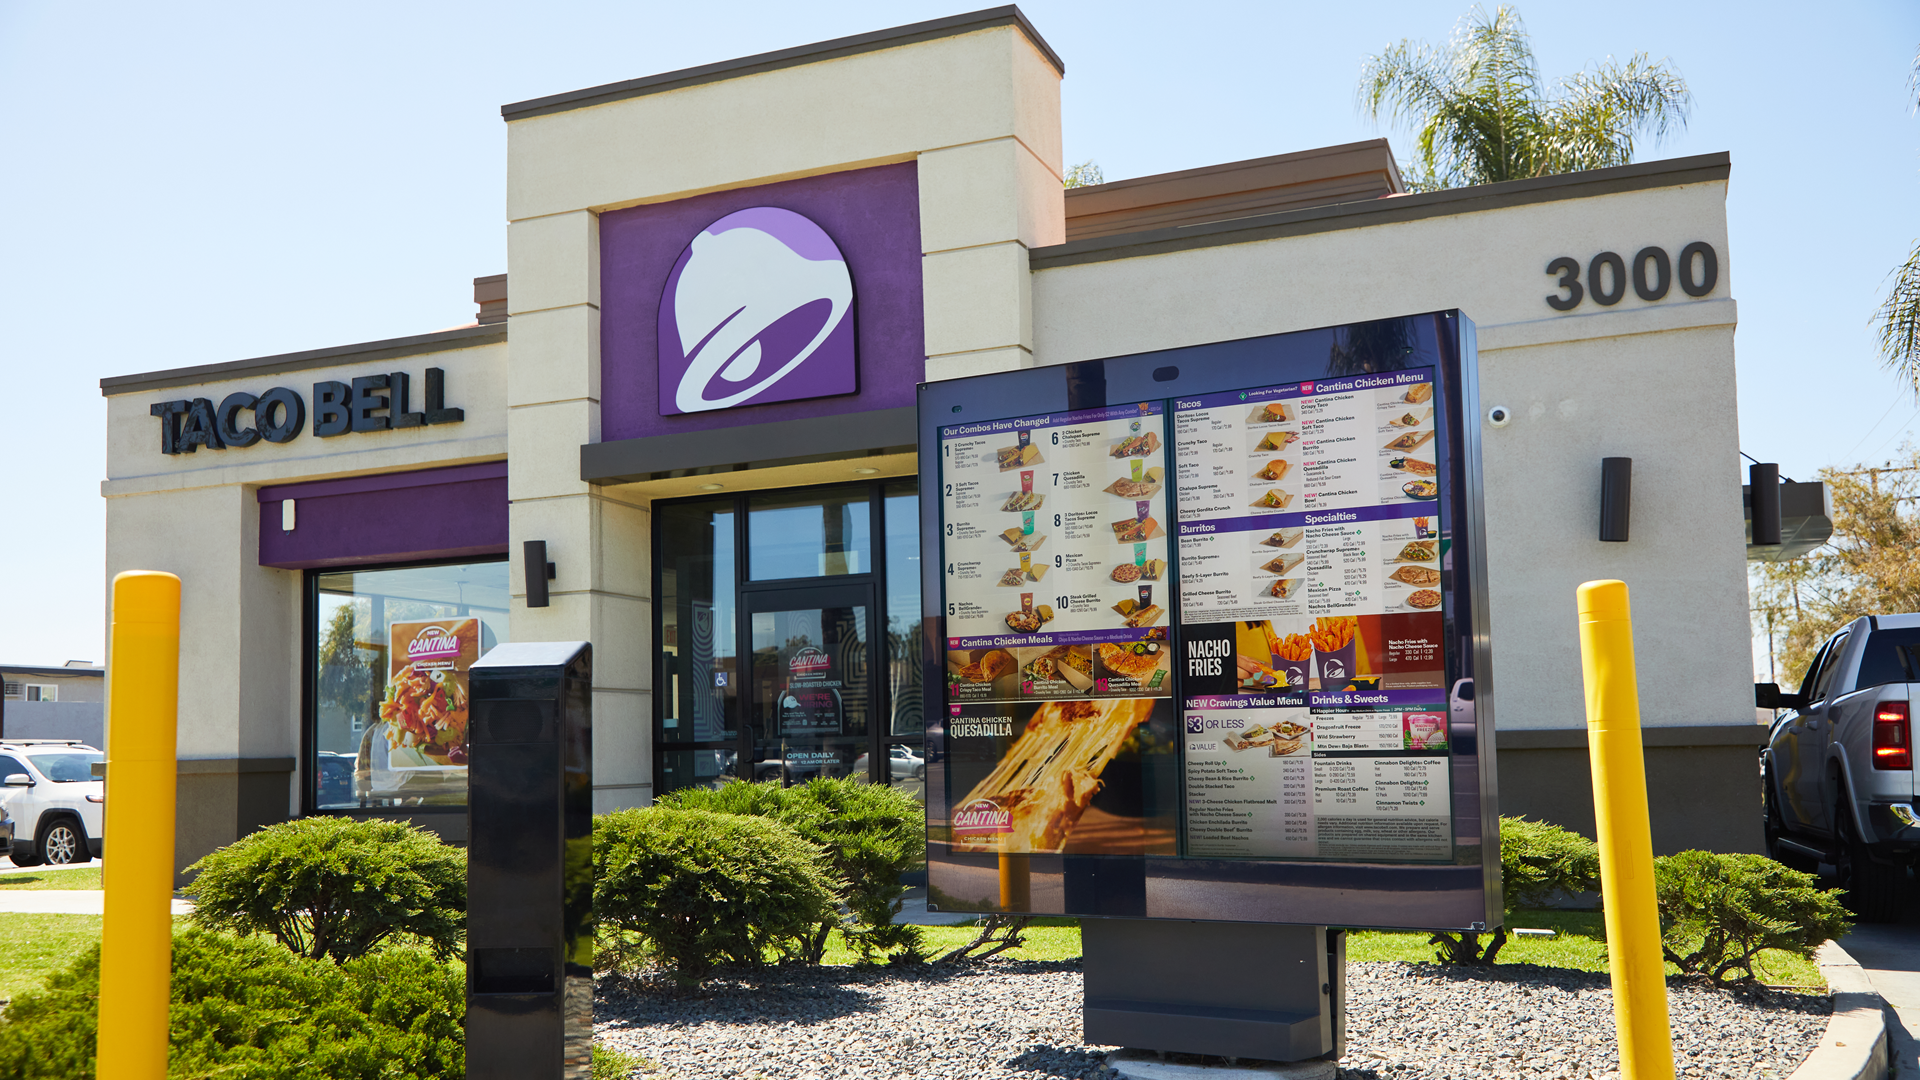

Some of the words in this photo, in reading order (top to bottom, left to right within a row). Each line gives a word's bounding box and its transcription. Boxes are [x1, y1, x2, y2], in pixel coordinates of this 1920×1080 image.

[1546, 241, 1718, 311] 3000
[1316, 382, 1353, 393] Cantina
[1354, 377, 1394, 388] Chicken
[1396, 373, 1424, 384] Menu
[1272, 386, 1298, 394] Vegetarian?
[150, 387, 306, 454] TACO
[313, 367, 464, 437] BELL
[1176, 400, 1202, 410] Tacos
[943, 428, 958, 436] Our
[959, 424, 991, 434] Combos
[993, 422, 1012, 430] Have
[1014, 416, 1050, 427] Changed
[1051, 431, 1058, 445] 6
[944, 444, 949, 457] 1
[1052, 473, 1059, 486] 7
[946, 484, 953, 497] 2
[1054, 514, 1061, 527] 8
[1305, 511, 1357, 525] Specialties
[947, 523, 953, 536] 3
[1180, 524, 1216, 533] Burritos
[1055, 555, 1062, 568] 9
[947, 563, 954, 575] 4
[1056, 596, 1068, 609] 10
[948, 603, 955, 616] 5
[408, 635, 458, 654] CANTINA
[961, 637, 992, 647] Cantina
[994, 636, 1025, 646] Chicken
[1026, 635, 1053, 645] Meals
[1188, 639, 1231, 659] NACHO
[789, 654, 828, 667] CANTINA
[1188, 658, 1222, 677] FRIES
[789, 681, 822, 689] SLOW-ROASTED
[950, 683, 959, 696] 11
[1021, 681, 1033, 694] 12
[1096, 678, 1108, 691] 13
[799, 693, 831, 701] WE'RE
[1186, 699, 1208, 708] NEW
[1209, 698, 1248, 709] Cravings
[1250, 697, 1275, 706] Value
[1277, 696, 1303, 705] Menu
[1312, 695, 1343, 705] Drinks
[1344, 695, 1352, 704] &
[1353, 694, 1388, 703] Sweets
[800, 700, 833, 708] HIRING
[981, 716, 1012, 724] CHICKEN
[1187, 717, 1203, 732] $3
[1205, 720, 1219, 729] OR
[1221, 719, 1244, 729] LESS
[950, 723, 1013, 739] QUESADILLA
[954, 810, 1010, 826] CANTINA
